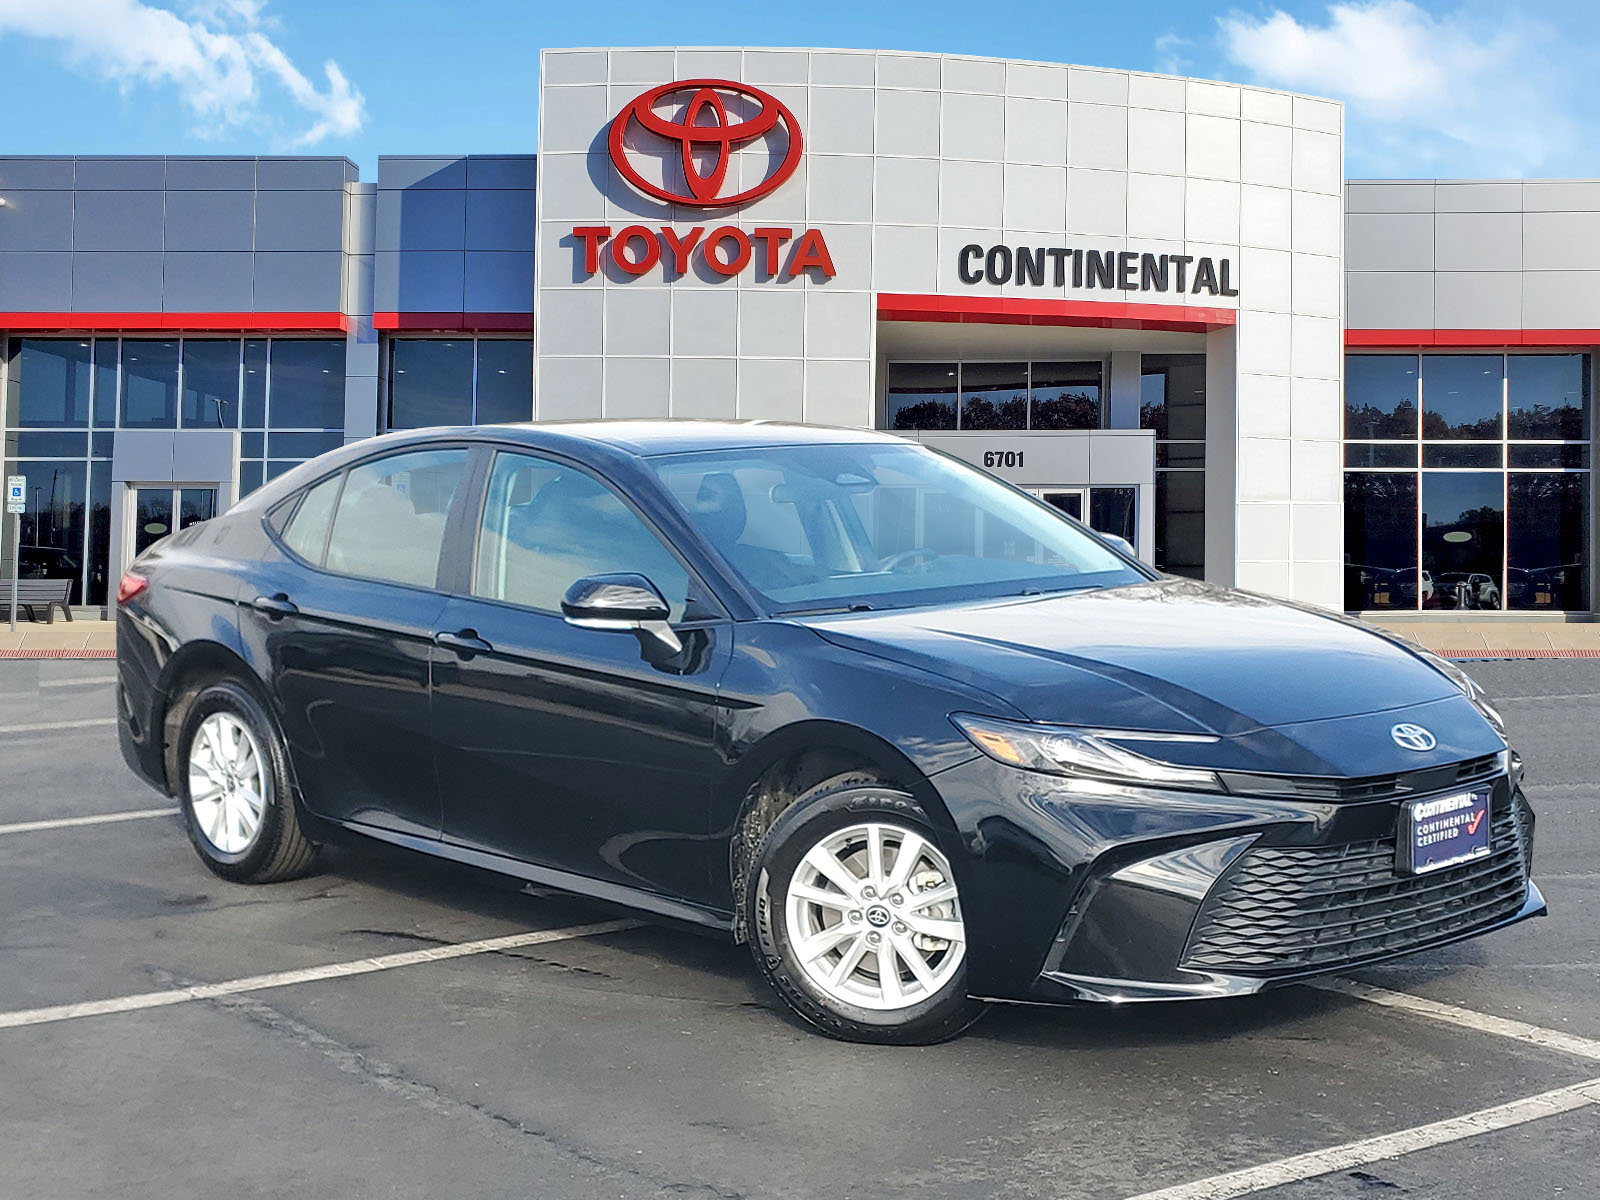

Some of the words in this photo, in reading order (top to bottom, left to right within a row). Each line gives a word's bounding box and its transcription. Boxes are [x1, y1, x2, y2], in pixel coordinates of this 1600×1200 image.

[573, 225, 836, 276] TOYOTA
[958, 244, 1239, 296] CONTINENTAL
[984, 451, 1024, 468] 6701
[1417, 812, 1475, 836] CONTINENTAL
[1417, 828, 1459, 847] CERTIFIED
